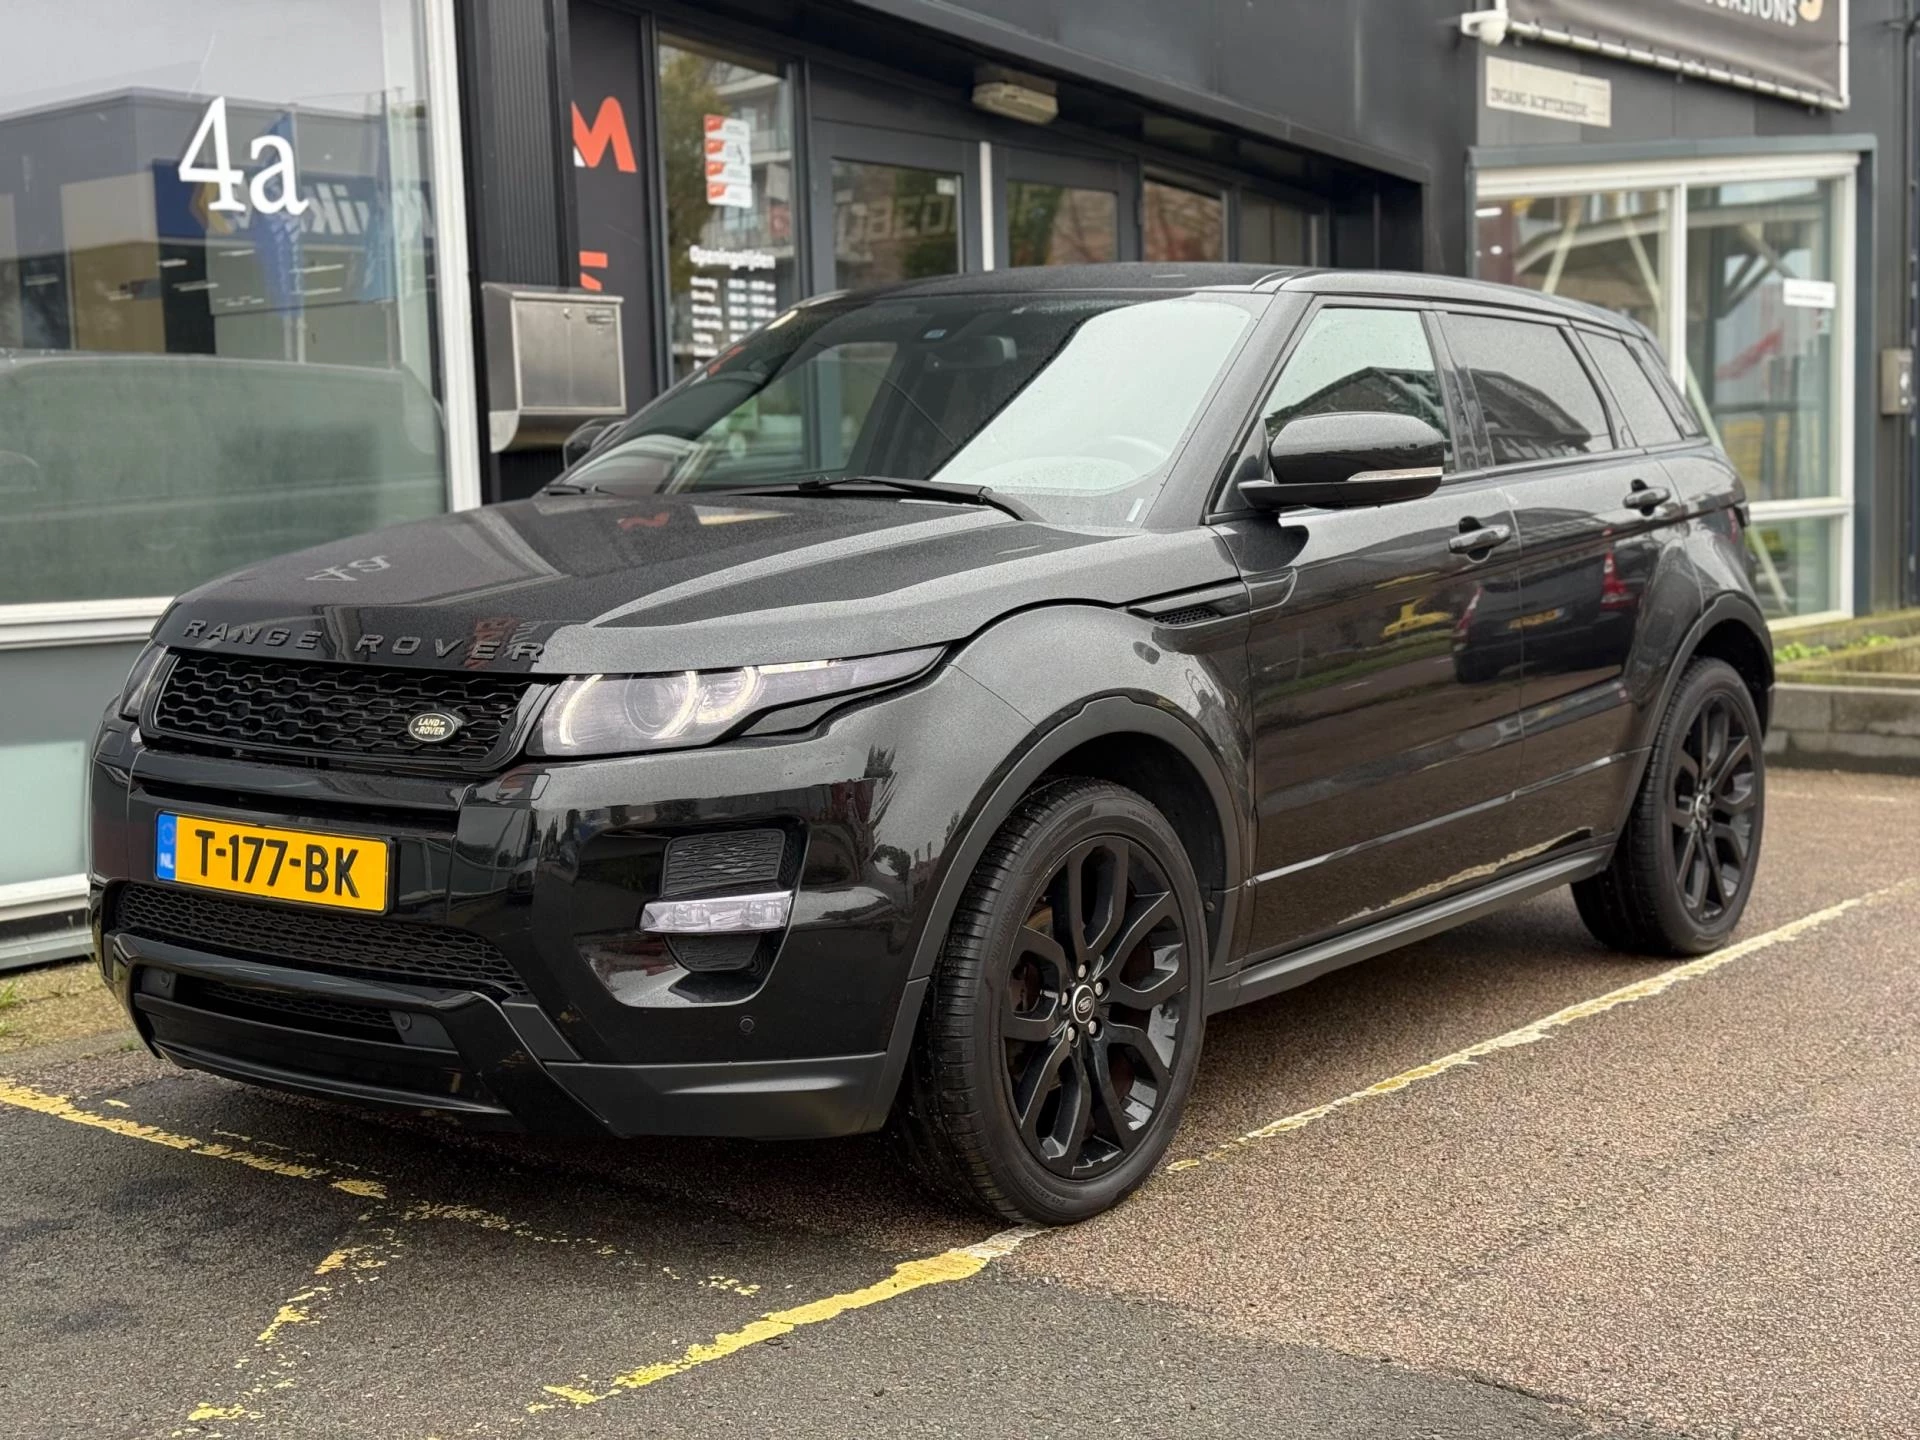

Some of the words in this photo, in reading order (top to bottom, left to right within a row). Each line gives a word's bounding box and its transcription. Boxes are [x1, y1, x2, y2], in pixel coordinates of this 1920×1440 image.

[178, 96, 309, 216] 4a
[184, 619, 323, 649] RANGE
[354, 634, 544, 663] ROVER
[418, 718, 440, 727] LAND
[418, 726, 446, 735] ROVER
[160, 852, 174, 869] NL
[195, 829, 360, 898] T-177-BK
